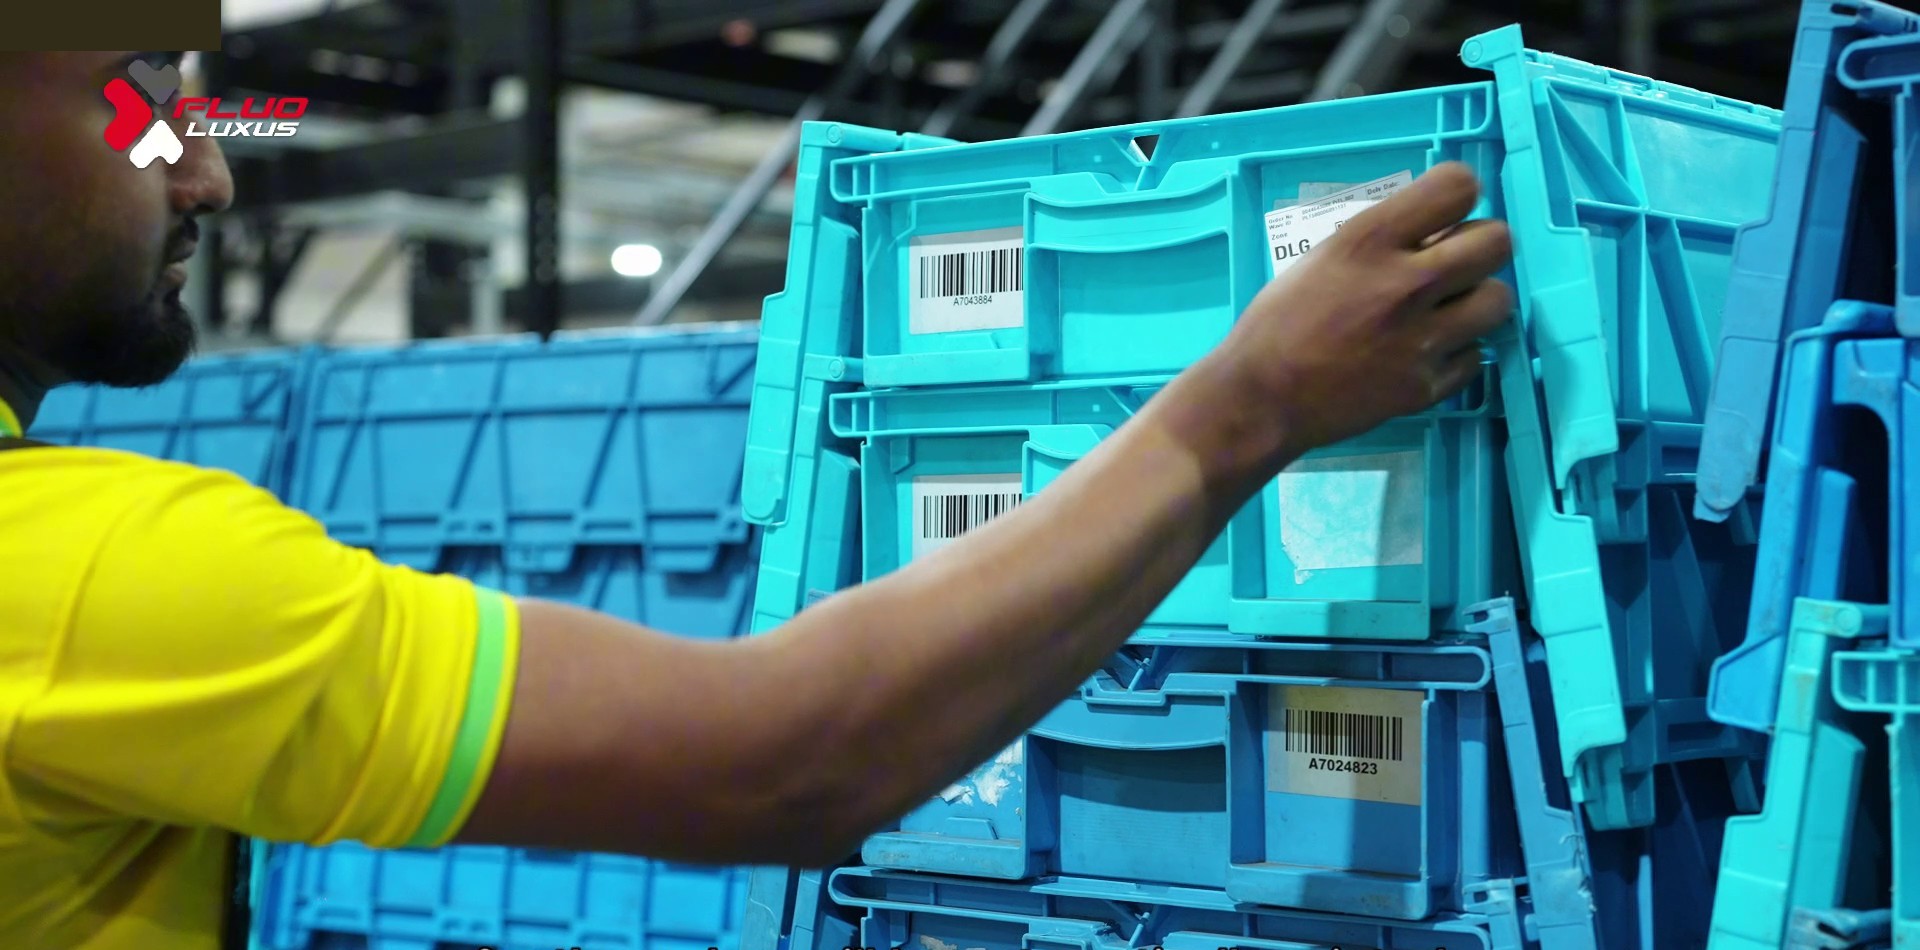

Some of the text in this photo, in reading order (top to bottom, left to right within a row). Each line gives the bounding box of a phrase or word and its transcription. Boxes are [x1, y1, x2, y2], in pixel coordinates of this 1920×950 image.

[1268, 216, 1284, 224] Order
[1271, 232, 1288, 241] Zone
[1275, 239, 1310, 260] DLG
[953, 294, 993, 307] A7043884
[1308, 757, 1378, 776] A7024823
